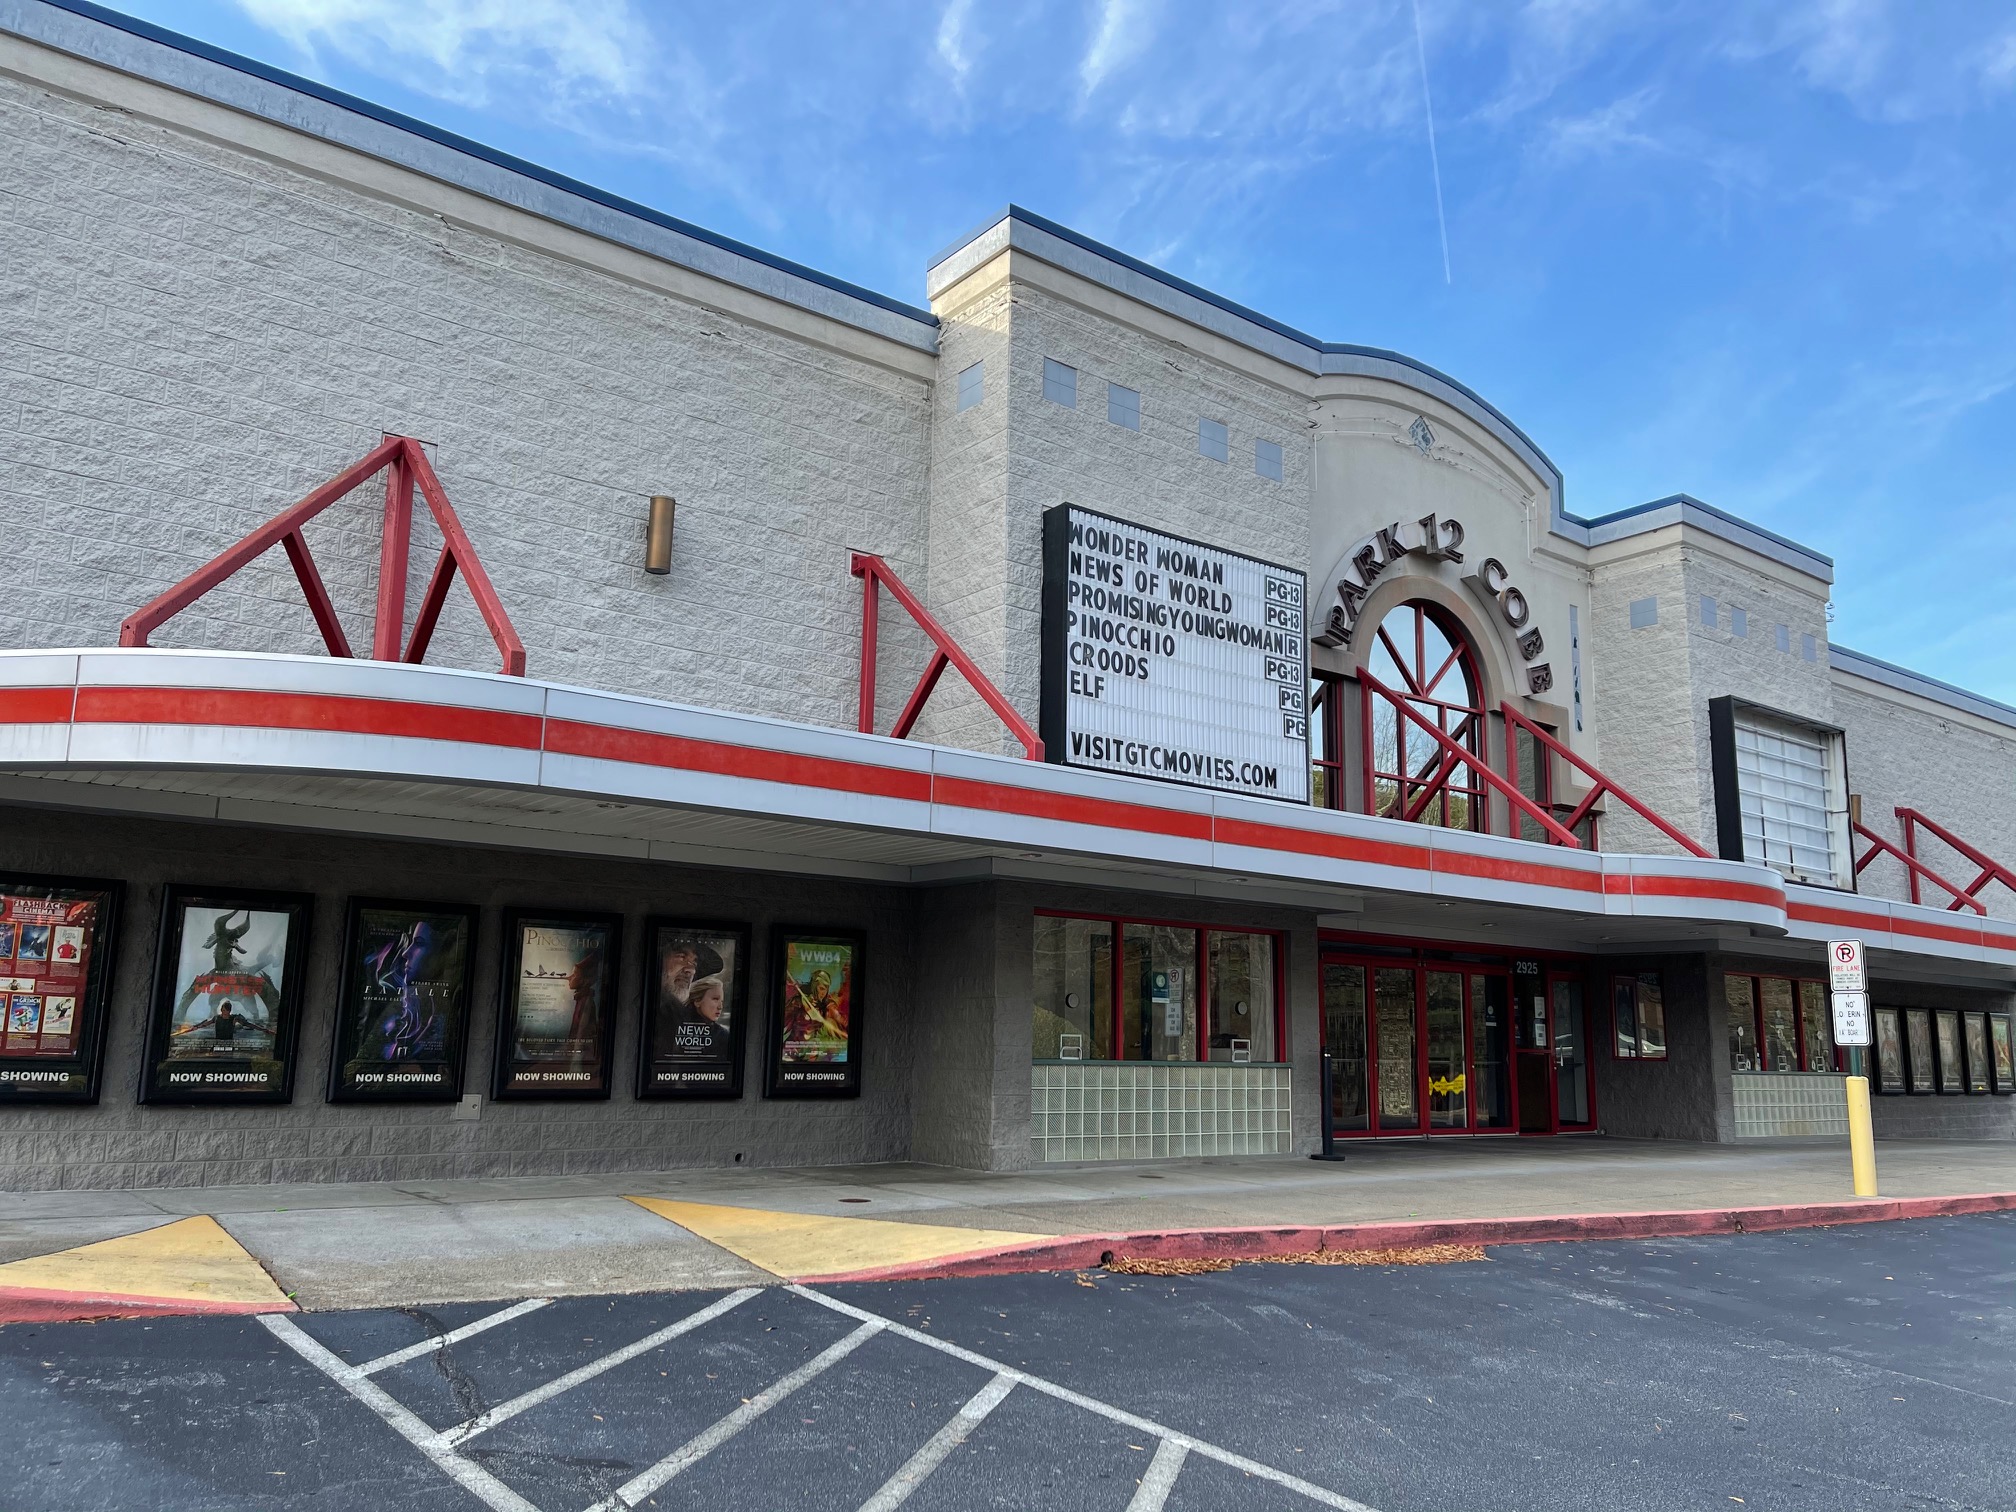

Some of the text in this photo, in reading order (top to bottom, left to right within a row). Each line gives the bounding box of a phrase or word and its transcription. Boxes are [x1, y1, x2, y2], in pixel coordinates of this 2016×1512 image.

[1069, 521, 1300, 604] WONDER WOMAN PG-13
[1070, 551, 1299, 630] NEWS OF WORLD PG-13
[1325, 512, 1554, 694] PARK 12 COBB
[1068, 580, 1298, 656] PROMISINGYOUNGWOMAN R
[1067, 610, 1299, 684] PINOCCHIO PG-13
[1069, 641, 1301, 709] CROODS PG
[1070, 670, 1305, 737] ELF PG
[1071, 731, 1277, 789] VISITGTCMOVIES.COM
[13, 899, 66, 910] FLASHBACK
[800, 949, 841, 963] WW84
[1516, 961, 1538, 975] 2925
[364, 985, 450, 997] FATALE
[1837, 1010, 1864, 1018] OERIN
[677, 1026, 710, 1036] NEWS
[675, 1037, 712, 1046] WORLD
[0, 1071, 70, 1082] SHOWING
[170, 1073, 268, 1082] NOW SHOWING
[355, 1073, 442, 1082] NOW SHOWING
[515, 1072, 591, 1081] NOW SHOWING
[657, 1073, 725, 1081] NOW SHOWING
[784, 1073, 845, 1081] NOW SHOWING
